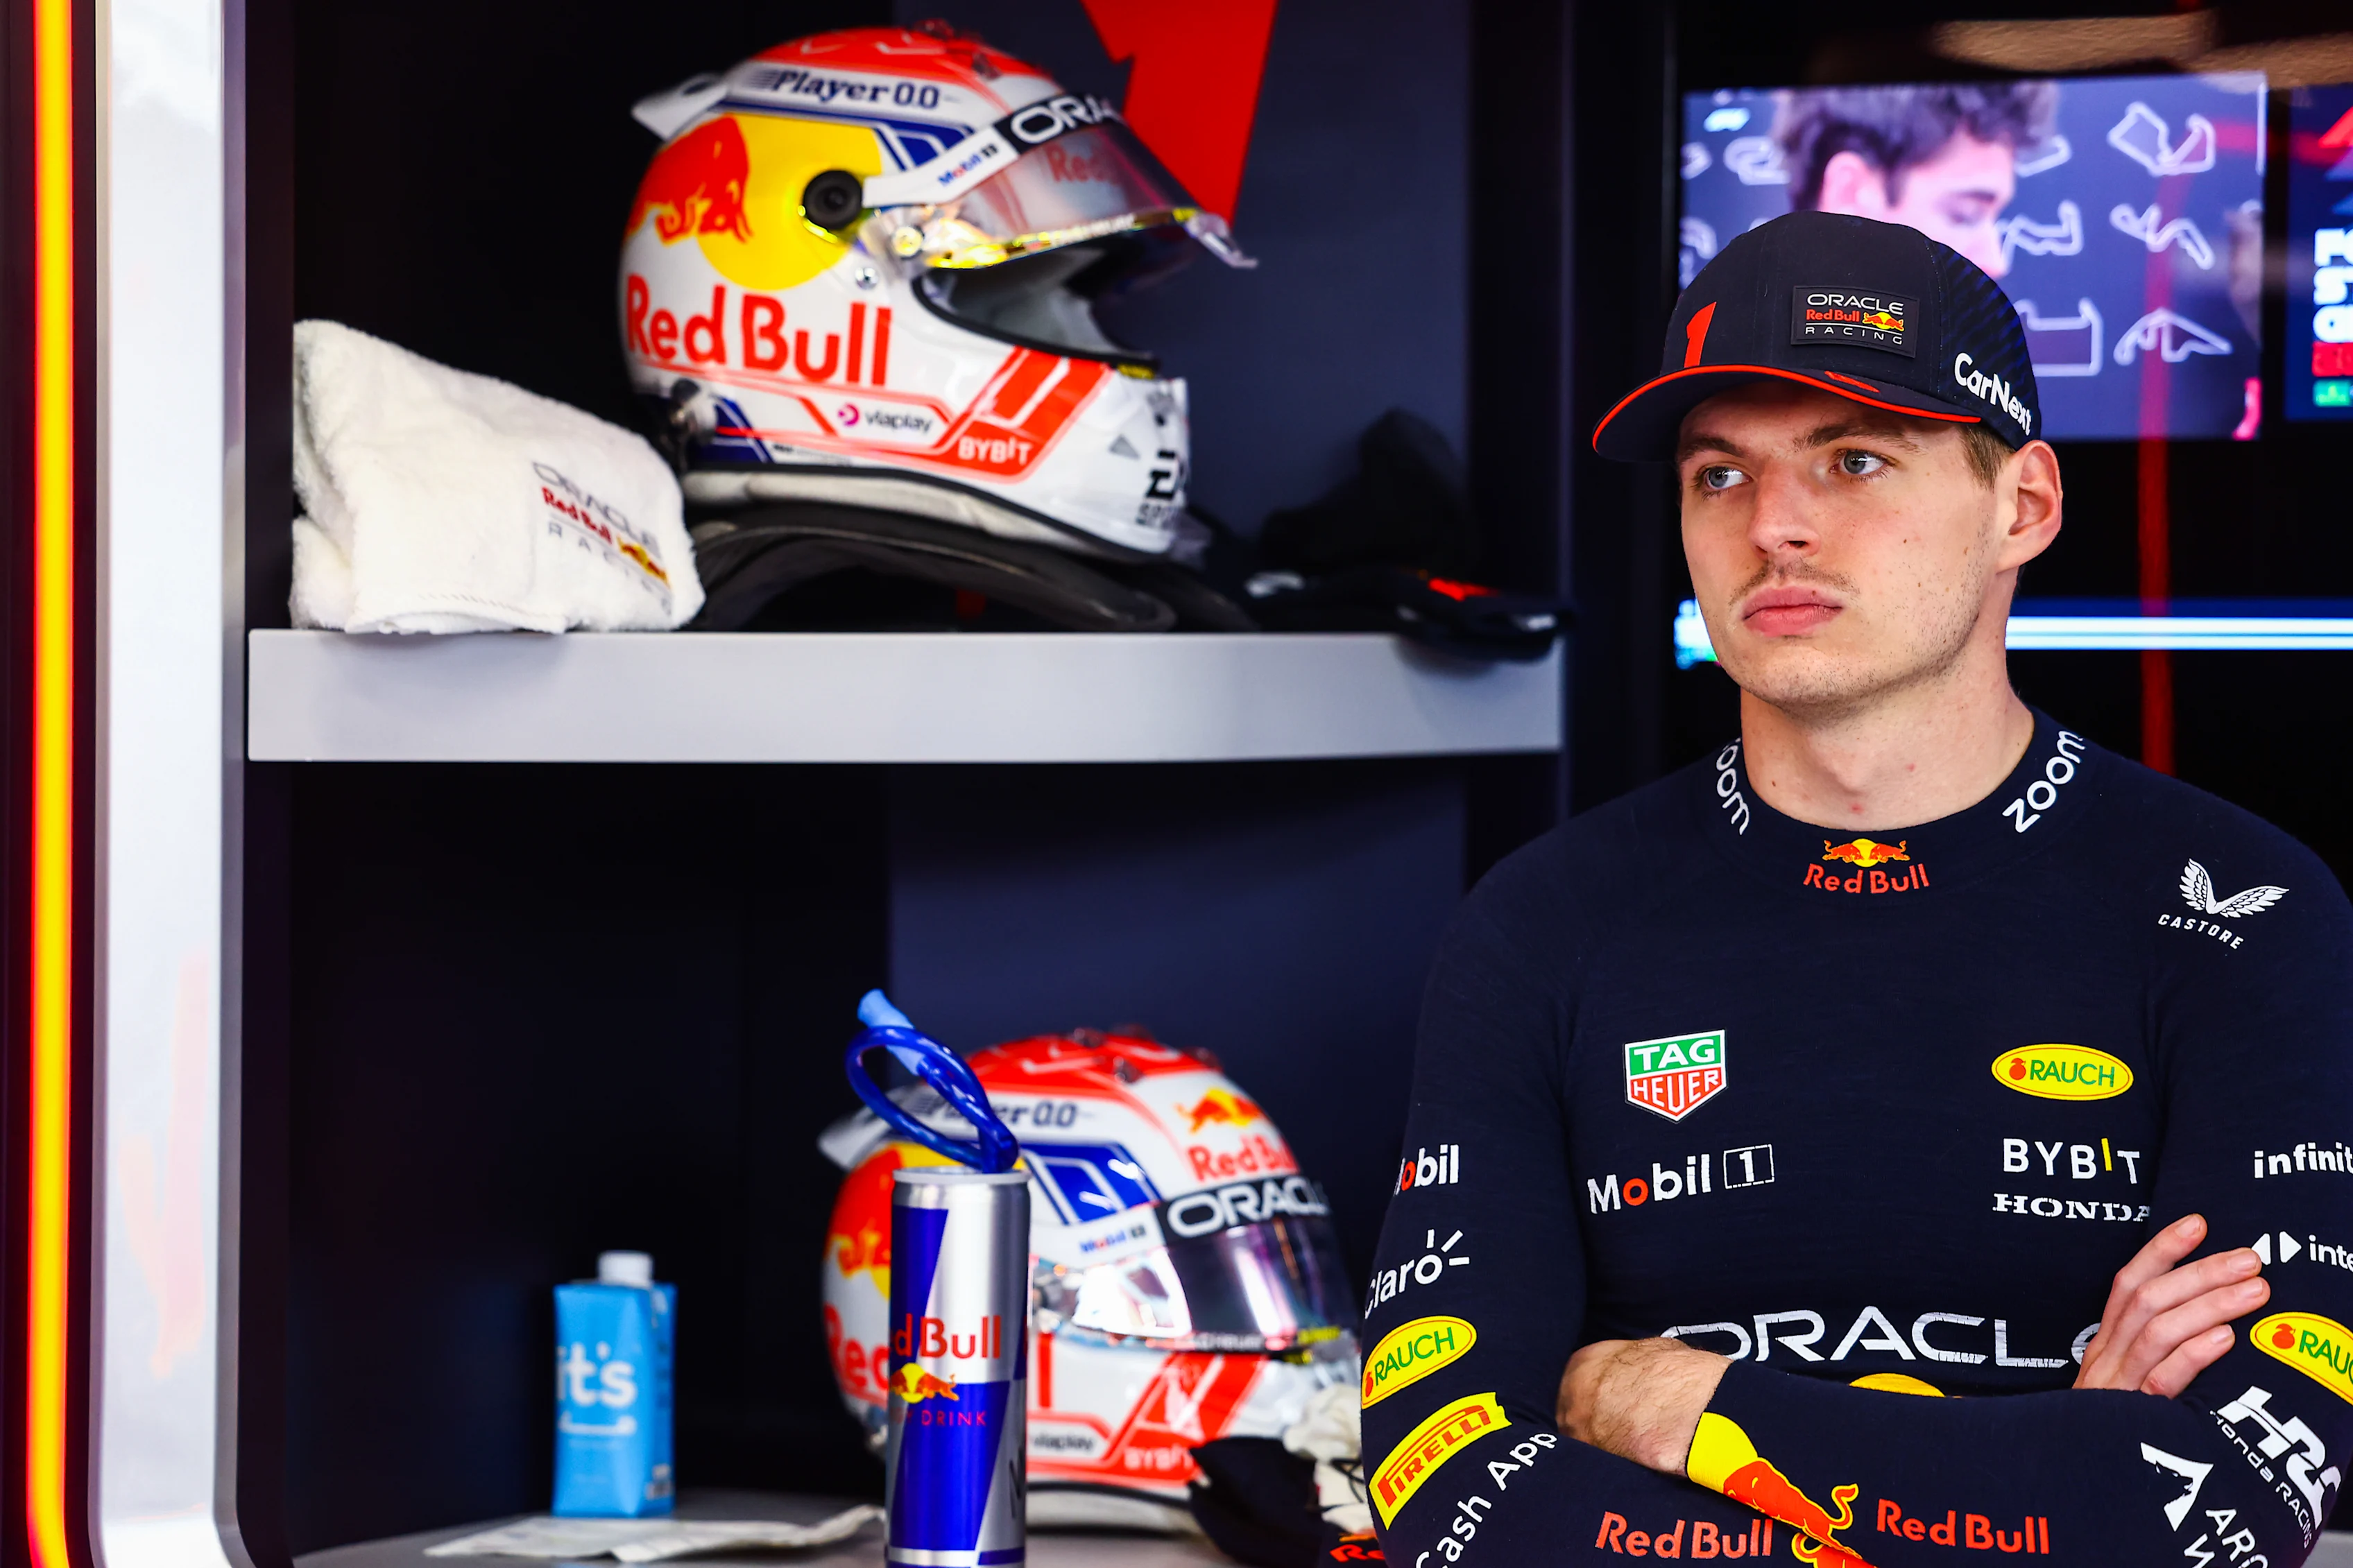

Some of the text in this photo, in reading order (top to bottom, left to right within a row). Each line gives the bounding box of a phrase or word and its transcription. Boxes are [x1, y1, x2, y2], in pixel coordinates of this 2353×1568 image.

[771, 69, 890, 103] Player
[1805, 309, 1861, 322] Red Bull
[1806, 293, 1904, 316] ORACLE
[626, 273, 892, 387] Red Bull
[1683, 301, 1717, 368] 1
[1805, 326, 1903, 345] RACING
[1953, 352, 2033, 437] CarNext
[864, 411, 934, 433] viaplay
[957, 434, 1035, 465] BYBIT
[1715, 737, 1750, 835] oom
[2002, 730, 2086, 833] zoom
[1803, 863, 1930, 894] Red Bull
[2157, 913, 2245, 950] CASTORE
[1633, 1038, 1715, 1071] TAG
[2029, 1058, 2114, 1088] RAUCH
[1632, 1069, 1719, 1114] HEUER
[1587, 1153, 1712, 1214] Mobil
[2003, 1137, 2141, 1184] BYBIT
[1992, 1193, 2150, 1223] HONDA
[919, 1313, 1002, 1359] Bull
[1374, 1326, 1455, 1386] RAUCH
[2298, 1329, 2353, 1387] RAU
[921, 1410, 988, 1427] DRINK
[1377, 1404, 1491, 1508] PIRELLI
[1487, 1432, 1558, 1492] App
[1595, 1510, 1773, 1560] Red Bull
[1876, 1499, 2051, 1555] Red Bull
[2275, 1481, 2313, 1549] RACING
